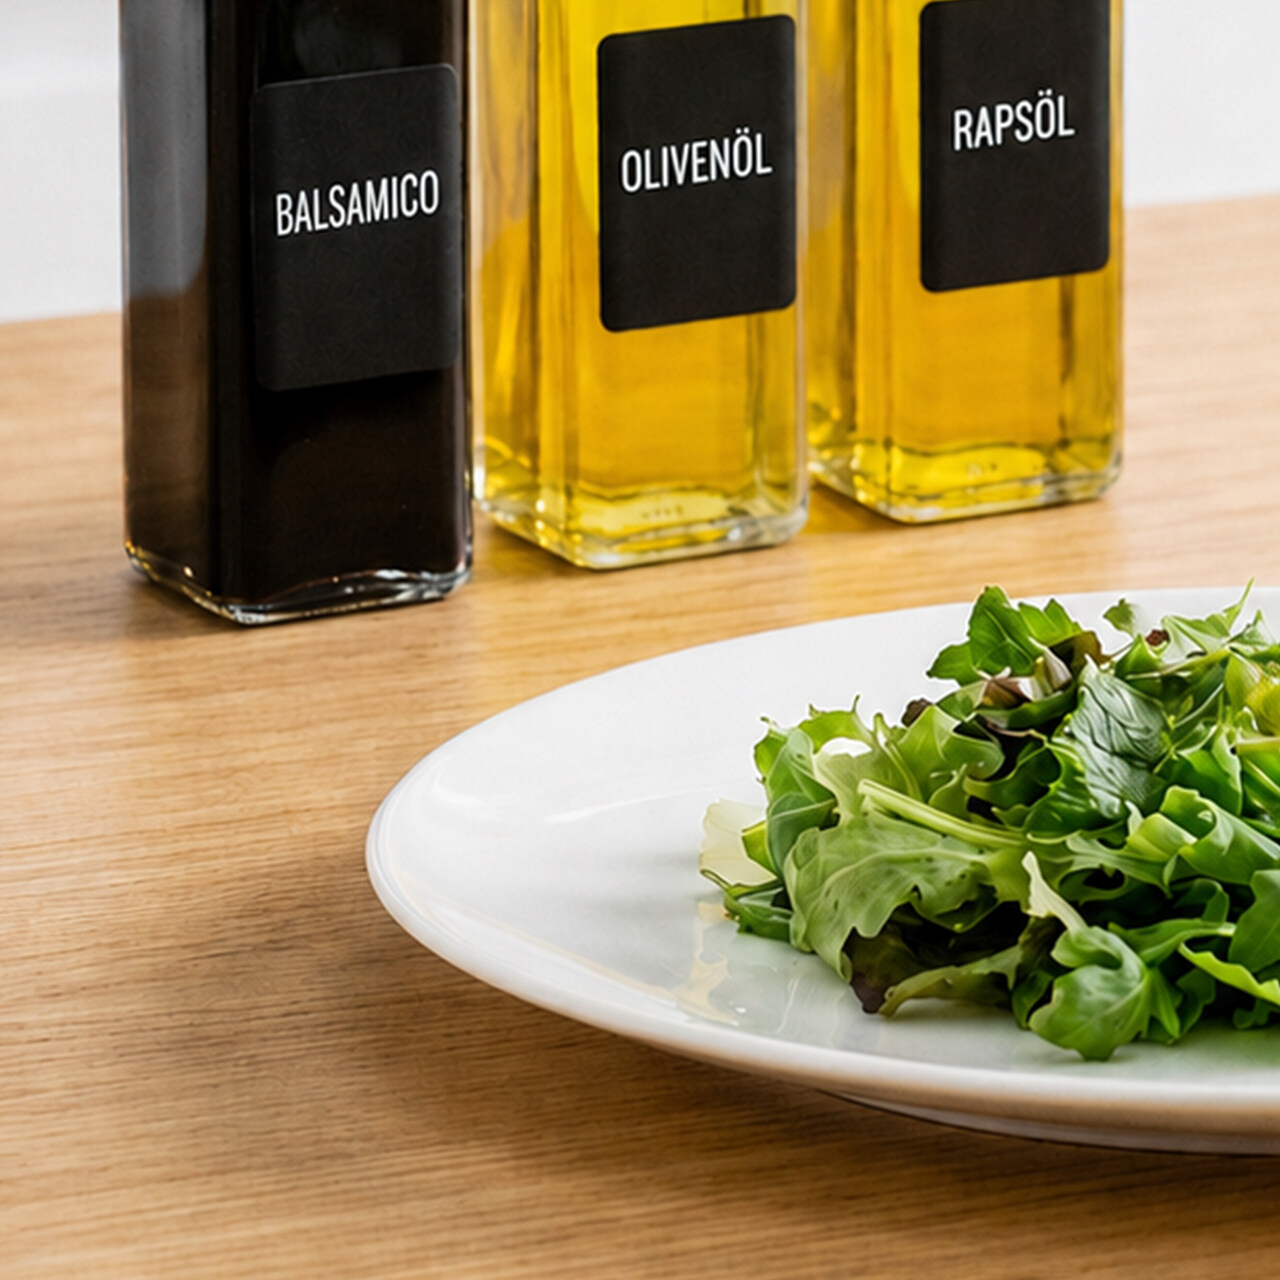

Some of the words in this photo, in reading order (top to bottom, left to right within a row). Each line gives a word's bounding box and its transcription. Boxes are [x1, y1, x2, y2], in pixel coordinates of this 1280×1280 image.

[954, 88, 1075, 151] RAPSÖL
[621, 126, 773, 193] OLIVENÖL
[276, 169, 439, 236] BALSAMICO
